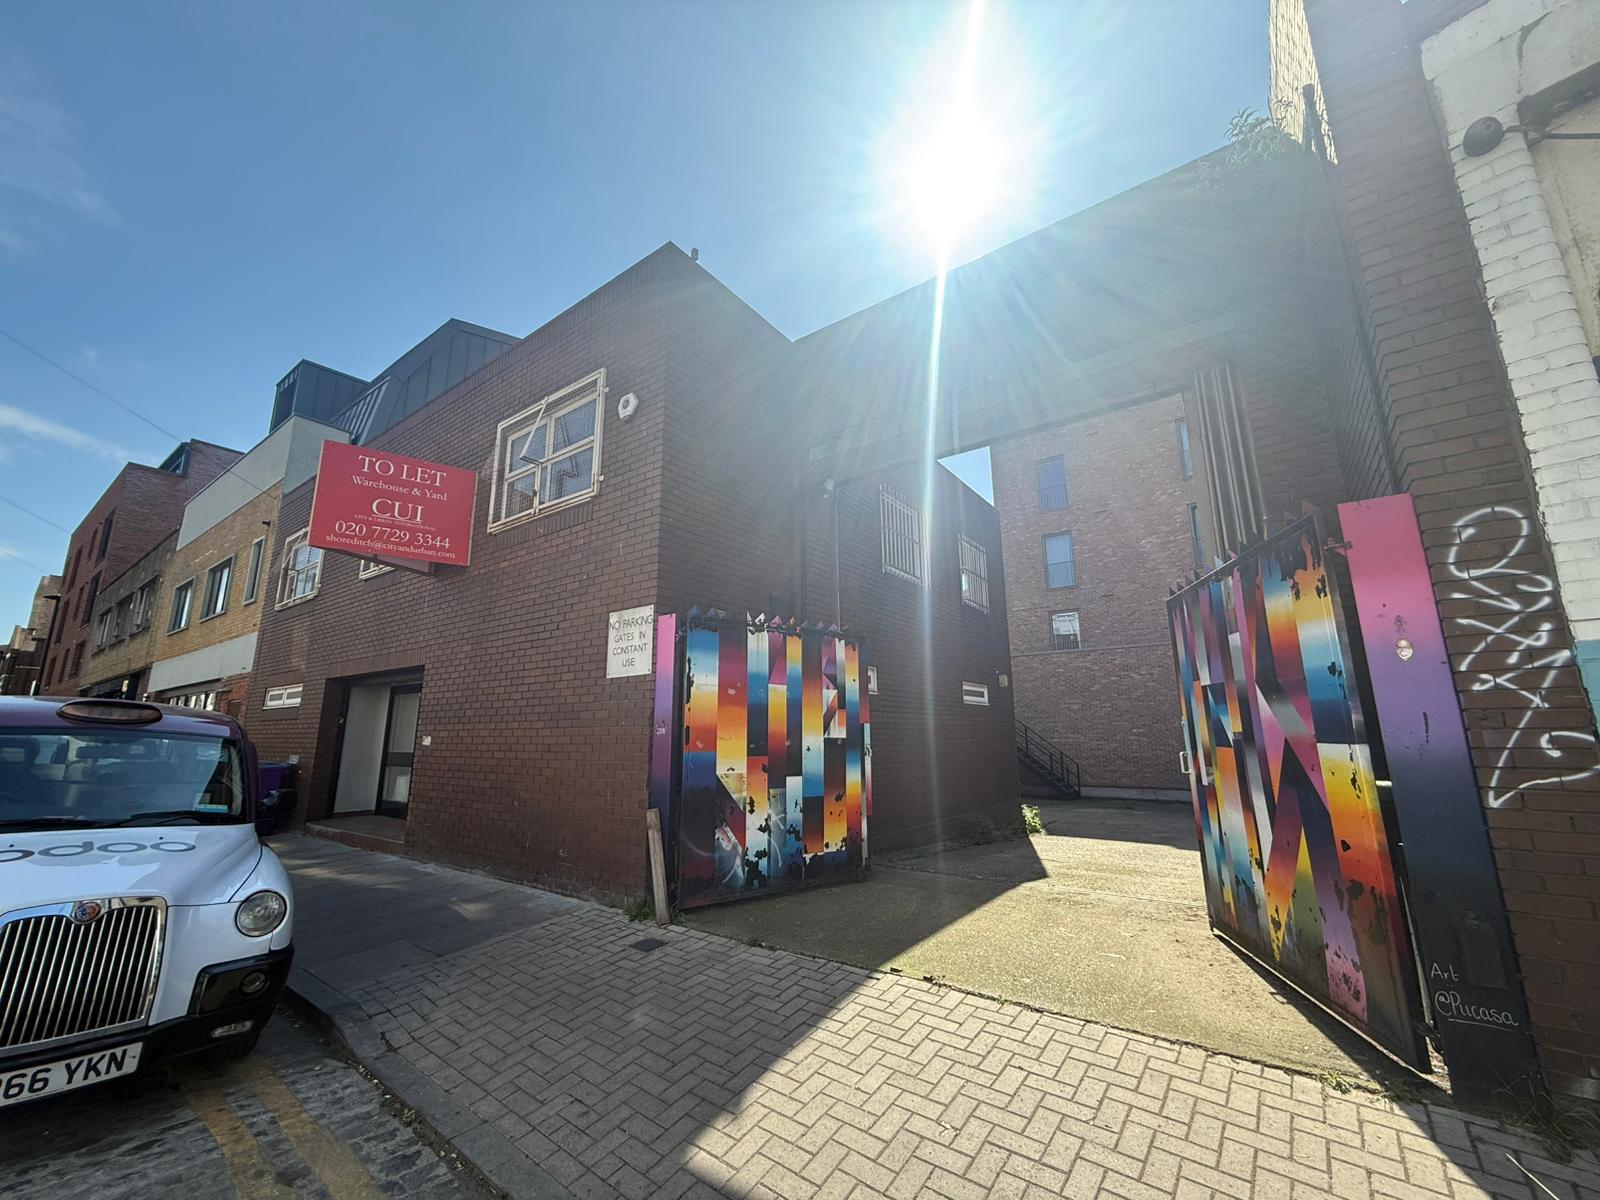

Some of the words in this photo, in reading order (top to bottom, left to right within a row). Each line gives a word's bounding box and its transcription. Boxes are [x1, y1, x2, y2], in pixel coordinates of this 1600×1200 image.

[358, 455, 394, 476] TO
[401, 464, 447, 487] LET
[352, 475, 409, 494] Warehouse
[411, 487, 422, 496] &
[425, 489, 447, 501] Yard
[372, 498, 424, 522] CUI
[326, 534, 456, 559] shoreditch@cityandurban.com
[335, 520, 366, 536] 020
[372, 525, 410, 543] 7729
[415, 533, 450, 549] 3344
[609, 620, 620, 631] NO
[623, 615, 653, 629] PARKING
[614, 632, 634, 643] GATES
[639, 631, 646, 640] IN
[612, 643, 648, 656] CONSTANT
[622, 658, 636, 667] USE
[1430, 962, 1459, 981] Art
[0, 1067, 52, 1099] 66
[64, 1048, 128, 1085] YKN
